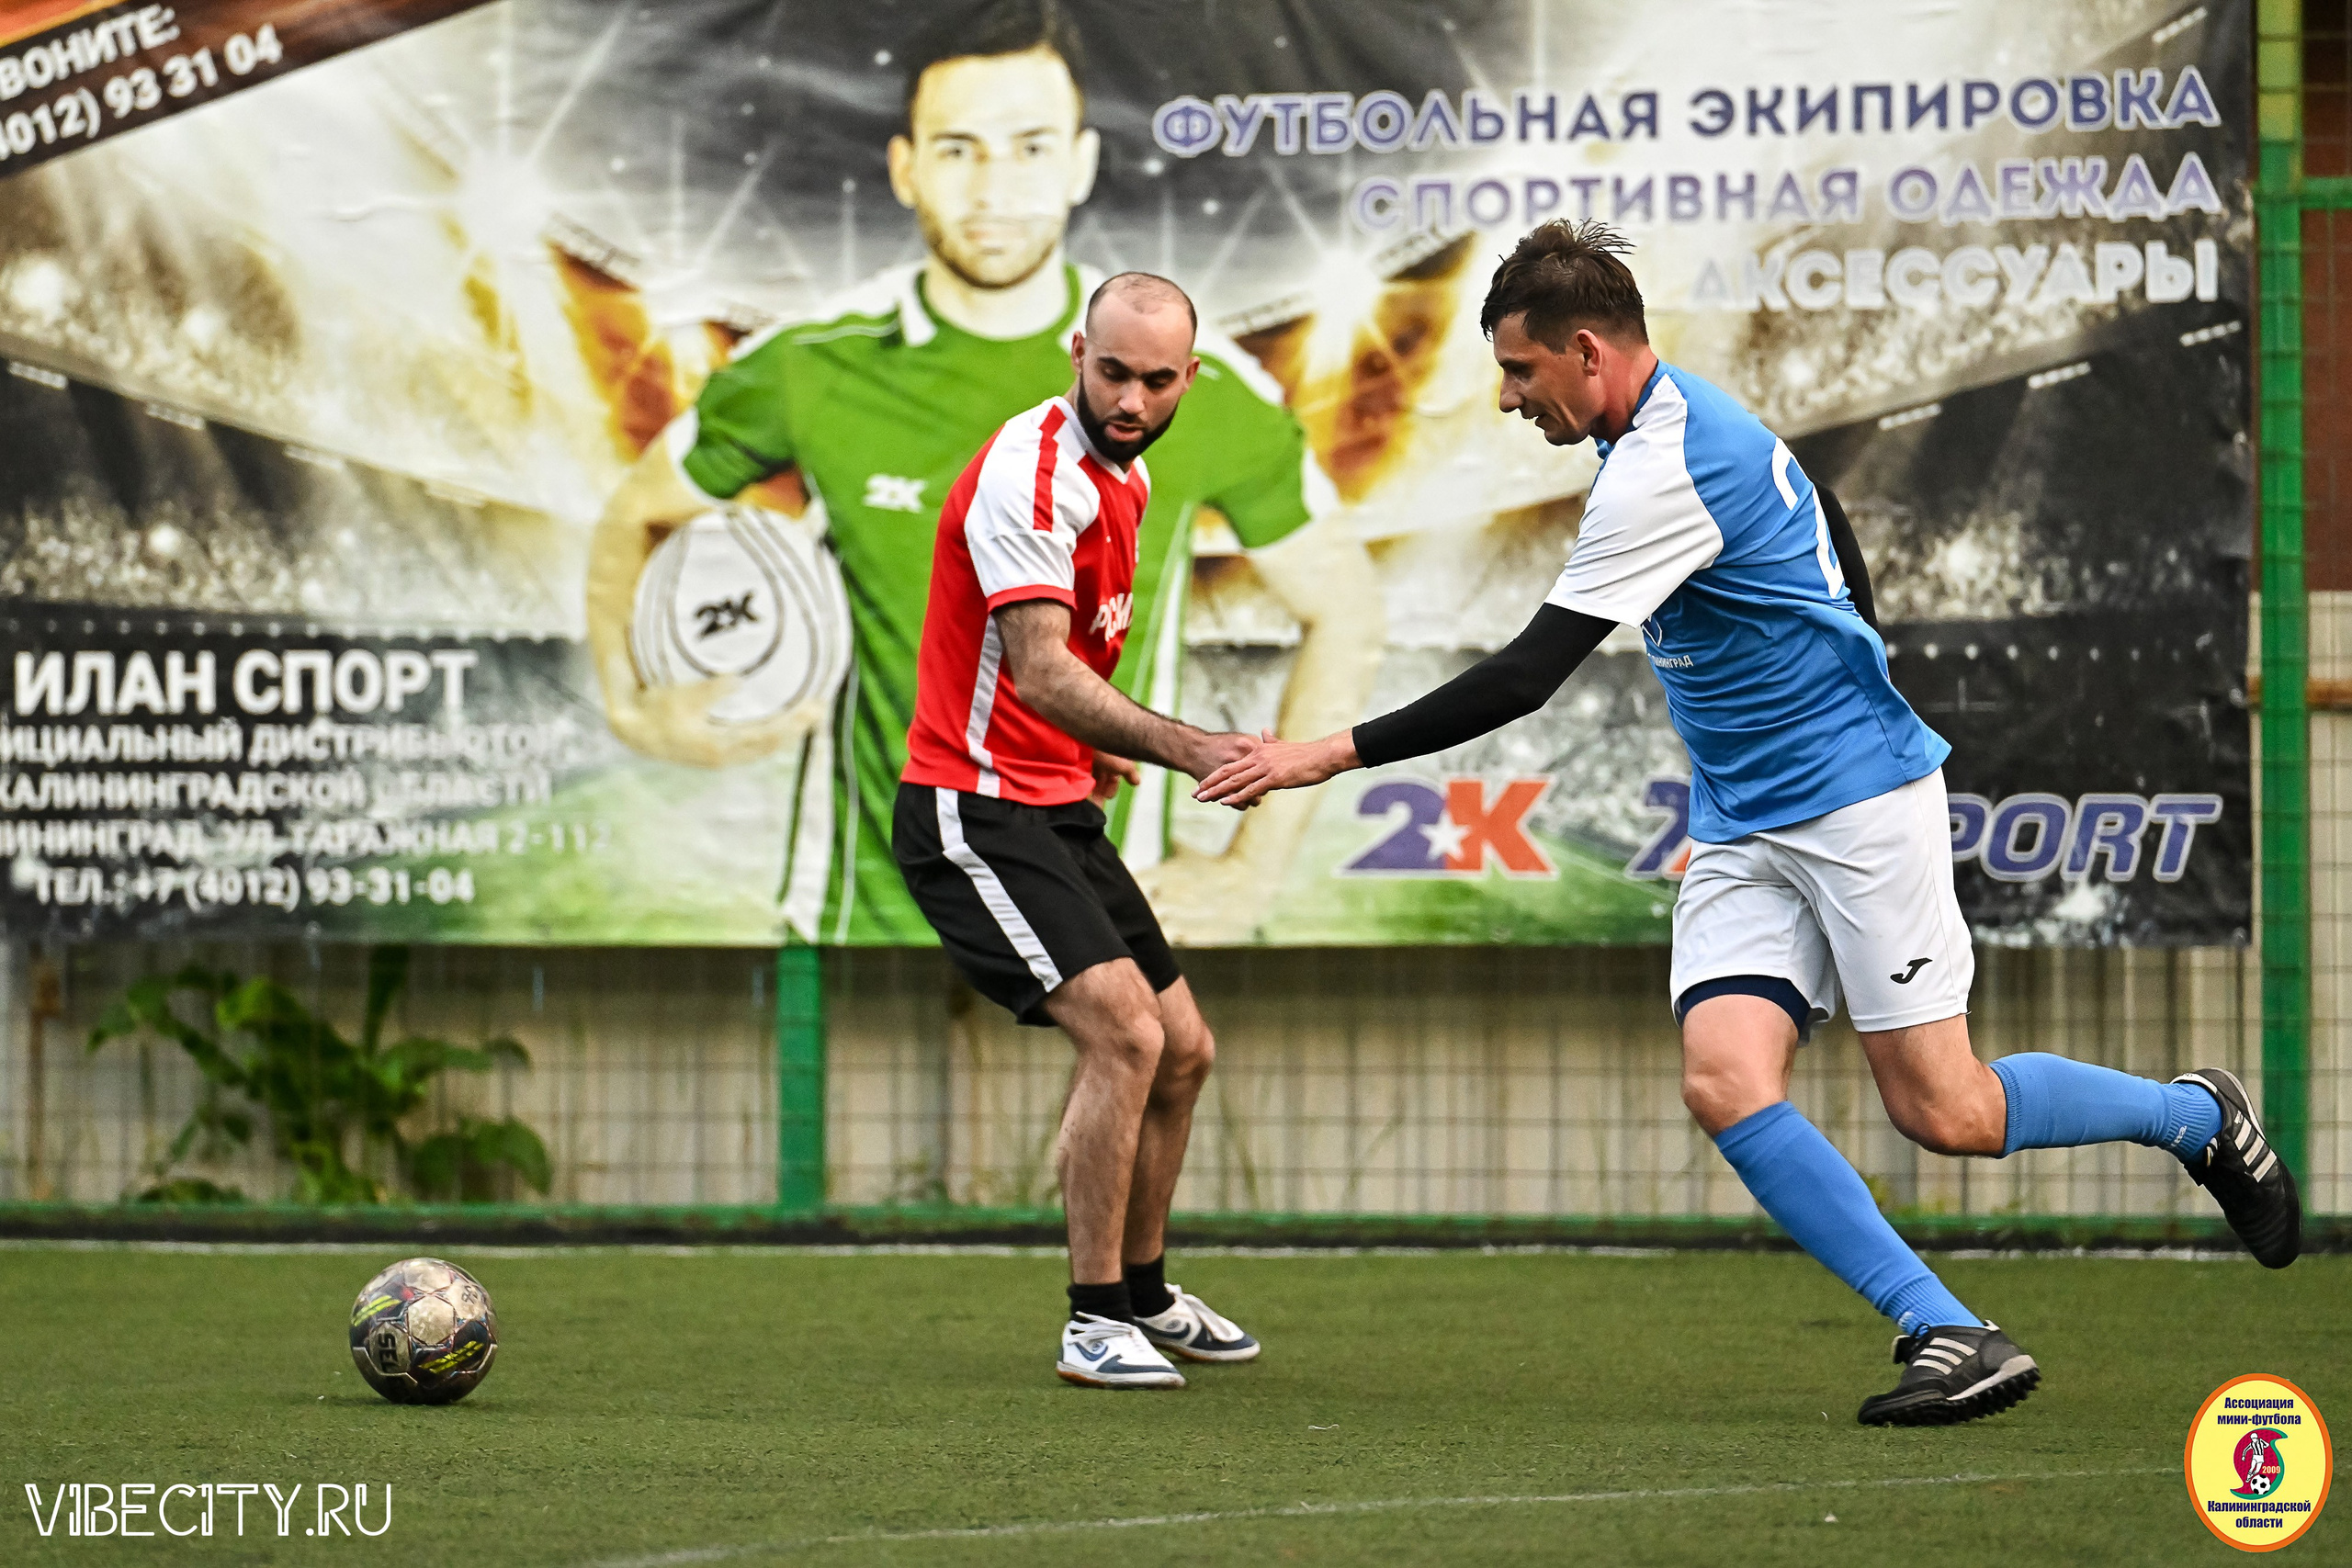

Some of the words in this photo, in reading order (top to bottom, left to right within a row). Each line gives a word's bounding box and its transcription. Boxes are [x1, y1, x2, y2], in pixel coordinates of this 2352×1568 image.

[103, 67, 163, 119] 93
[162, 46, 219, 97] 31
[223, 22, 284, 75] 04
[1152, 89, 1661, 158] ФУТБОЛЬНАЯ
[1689, 64, 2222, 138] ЭКИПИРОВКА
[1351, 167, 1861, 233] СПОРТИВНАЯ
[1886, 151, 2222, 228] ОДЕЖДА
[1689, 239, 2220, 313] АКСЕССУАРЫ
[14, 649, 218, 715] ИЛАН
[232, 649, 480, 715] СПОРТ
[1335, 776, 1557, 879] 2K
[305, 866, 475, 906] 93-31-04
